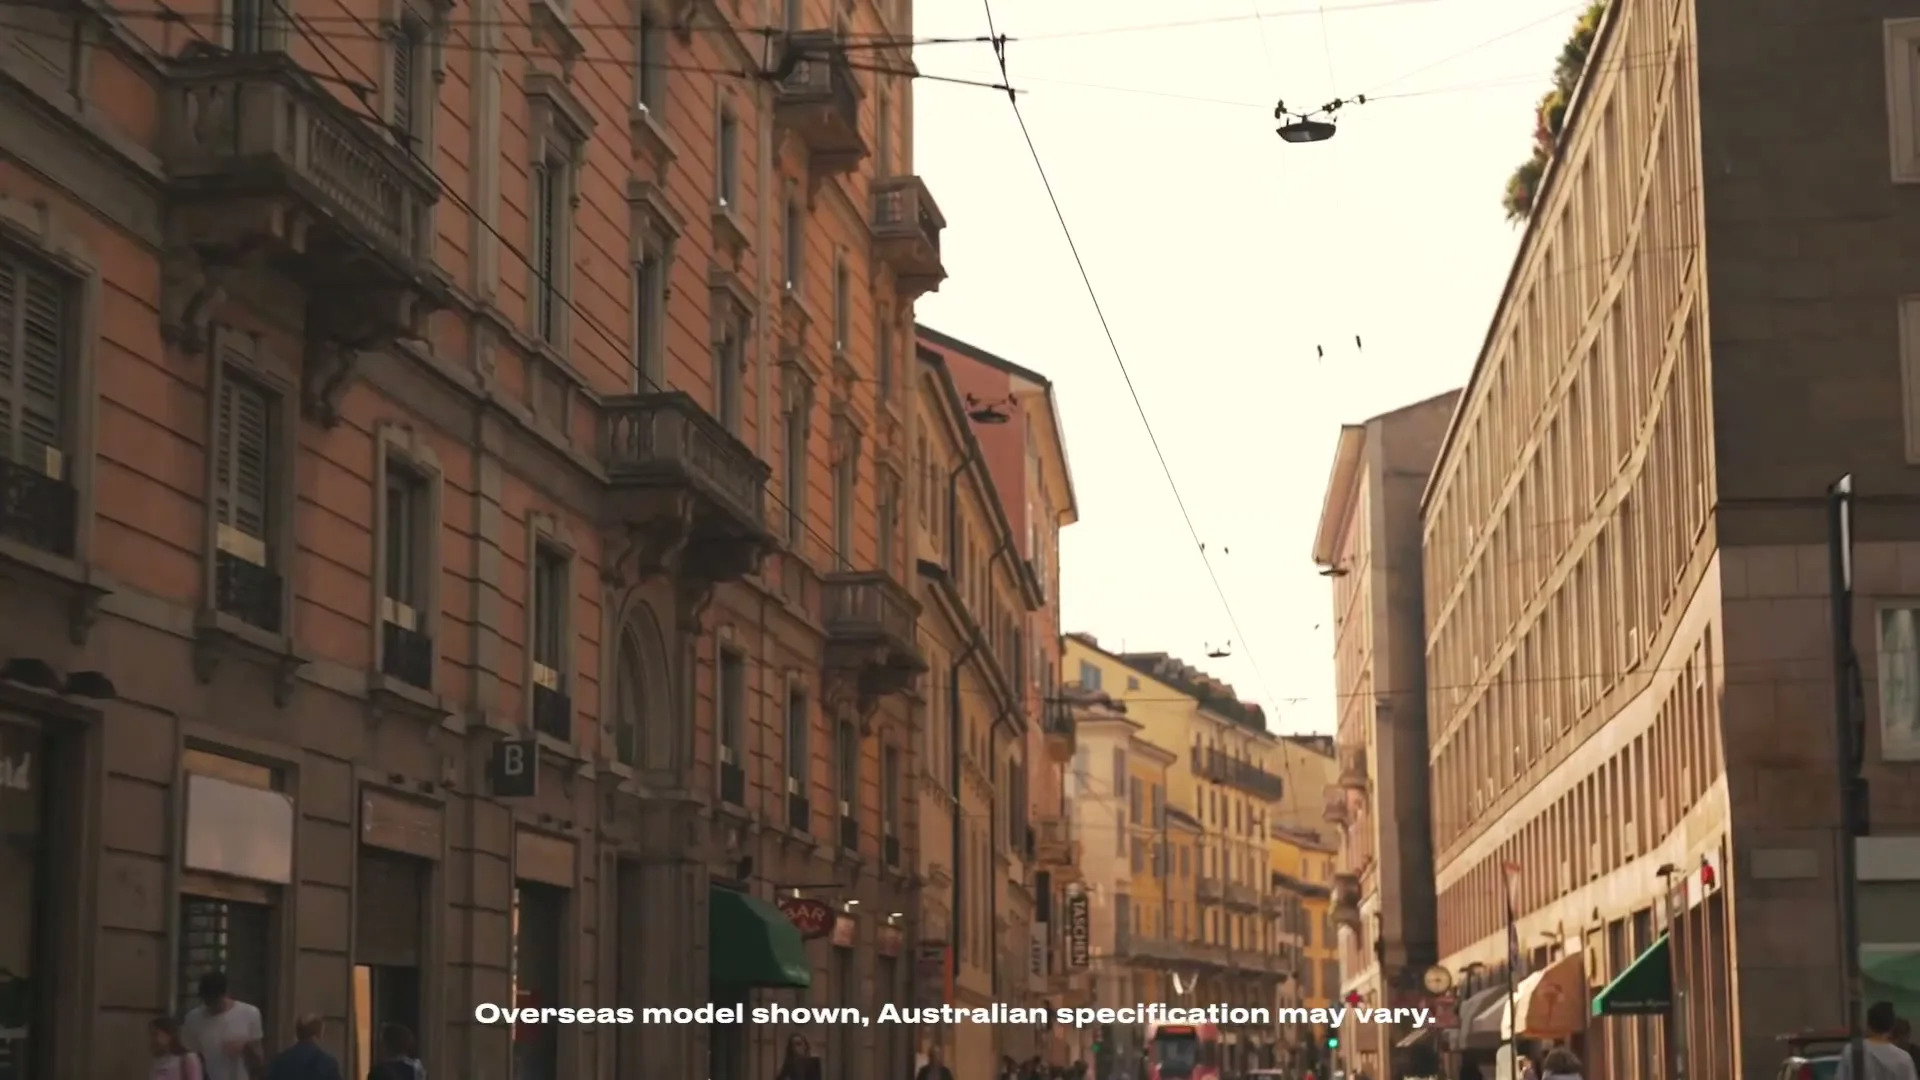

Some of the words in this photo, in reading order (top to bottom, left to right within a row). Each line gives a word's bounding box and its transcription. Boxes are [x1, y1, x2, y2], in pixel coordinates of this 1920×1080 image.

[505, 744, 523, 775] B
[784, 903, 826, 922] BAR
[1072, 900, 1087, 966] TASCHEN
